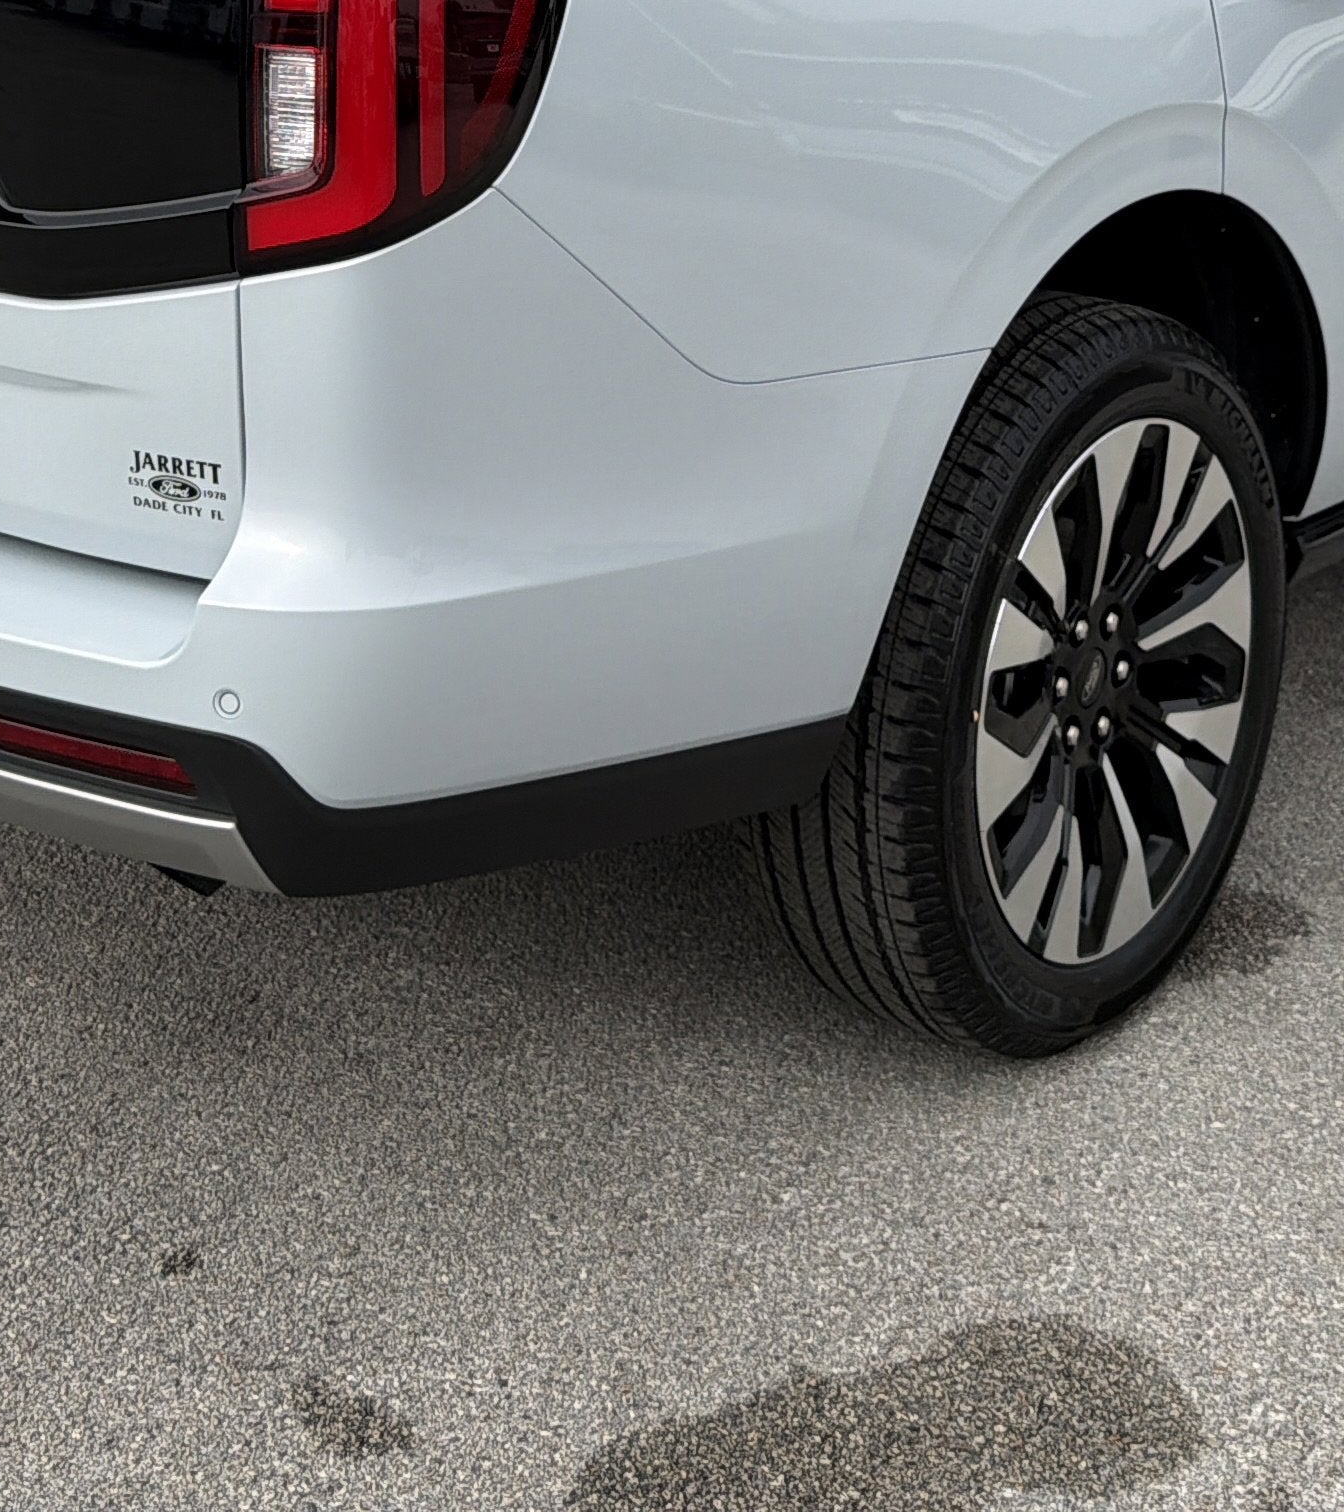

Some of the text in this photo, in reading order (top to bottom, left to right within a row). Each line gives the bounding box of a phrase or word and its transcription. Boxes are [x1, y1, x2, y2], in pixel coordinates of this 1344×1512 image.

[129, 450, 222, 485] JARRETT
[128, 476, 148, 488] EST.
[203, 489, 227, 501] 1978
[133, 496, 225, 521] DADE CITY FL
